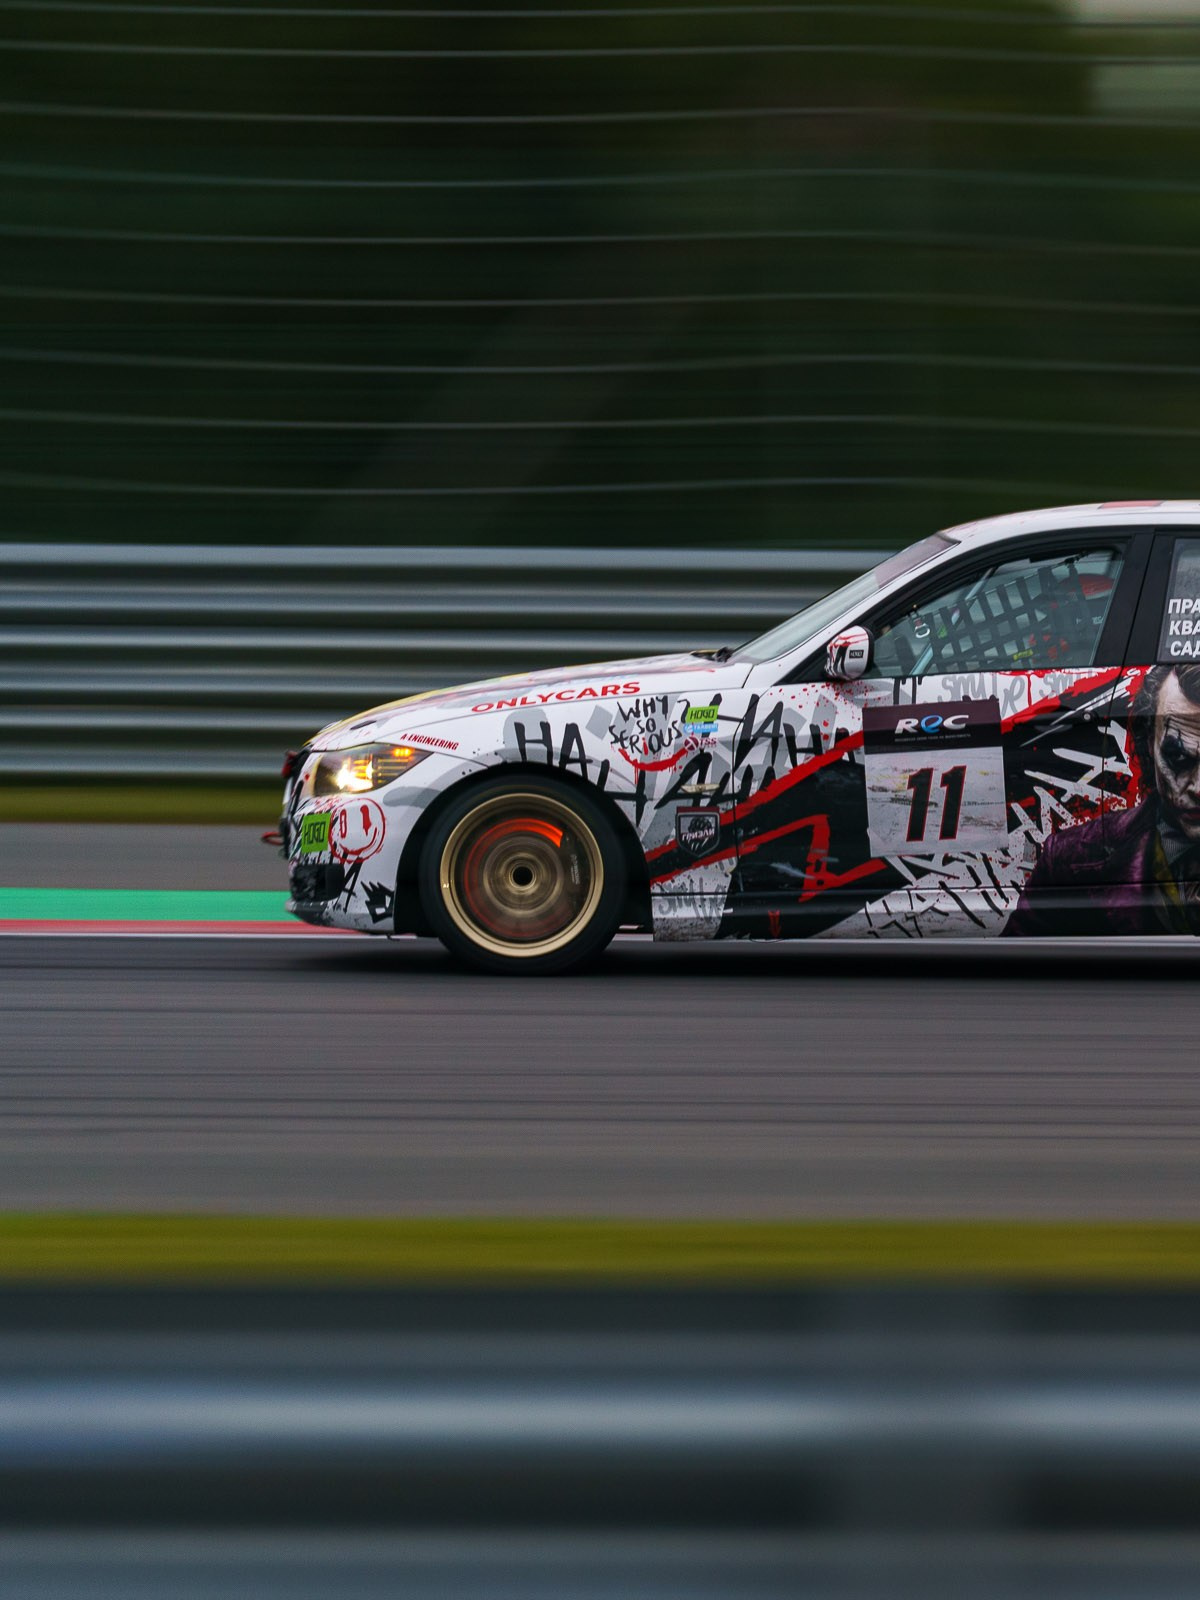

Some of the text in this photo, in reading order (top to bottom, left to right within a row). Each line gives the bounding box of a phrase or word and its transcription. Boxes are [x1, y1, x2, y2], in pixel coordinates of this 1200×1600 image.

[471, 681, 641, 713] ONLYCARS
[617, 695, 669, 722] WHY
[636, 718, 657, 734] SO
[690, 708, 716, 720] HOGO
[906, 765, 967, 842] 11
[303, 821, 327, 845] HOGO
